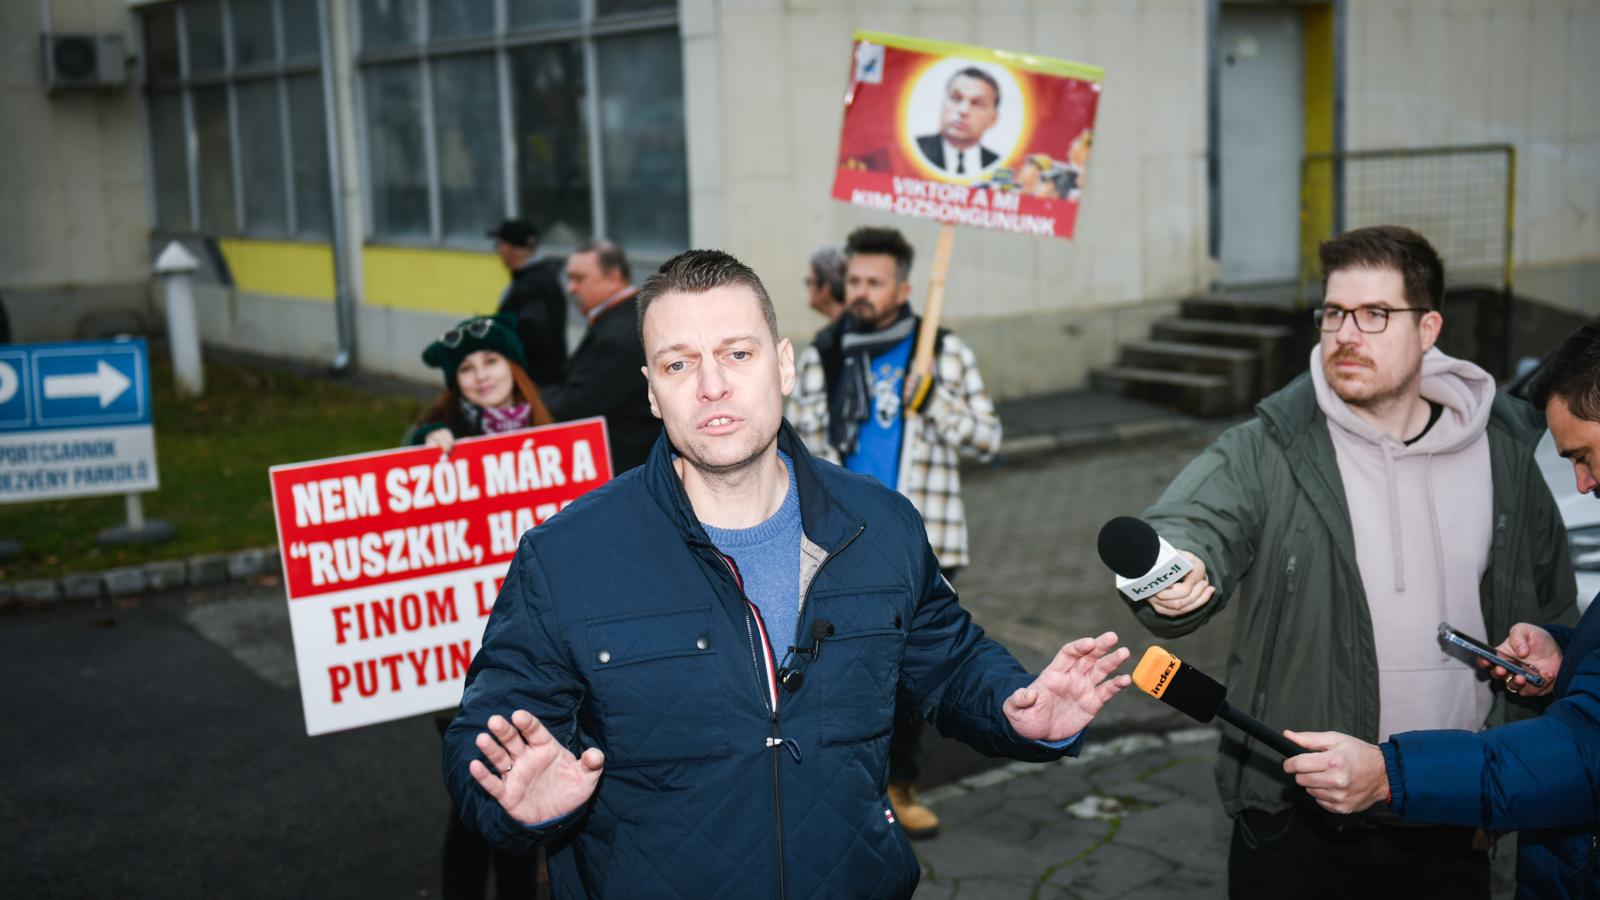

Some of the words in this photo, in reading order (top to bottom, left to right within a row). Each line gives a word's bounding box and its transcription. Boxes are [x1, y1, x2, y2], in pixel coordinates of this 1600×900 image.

[893, 176, 969, 205] VIKTOR
[972, 189, 989, 208] A
[992, 191, 1020, 212] MI
[73, 458, 148, 486] PARKOLÓ
[291, 473, 381, 528] NEM
[386, 453, 480, 512] SZÓL
[482, 438, 566, 498] MÁR
[572, 439, 598, 483] A
[332, 586, 459, 645] FINOM
[1151, 661, 1176, 695] index
